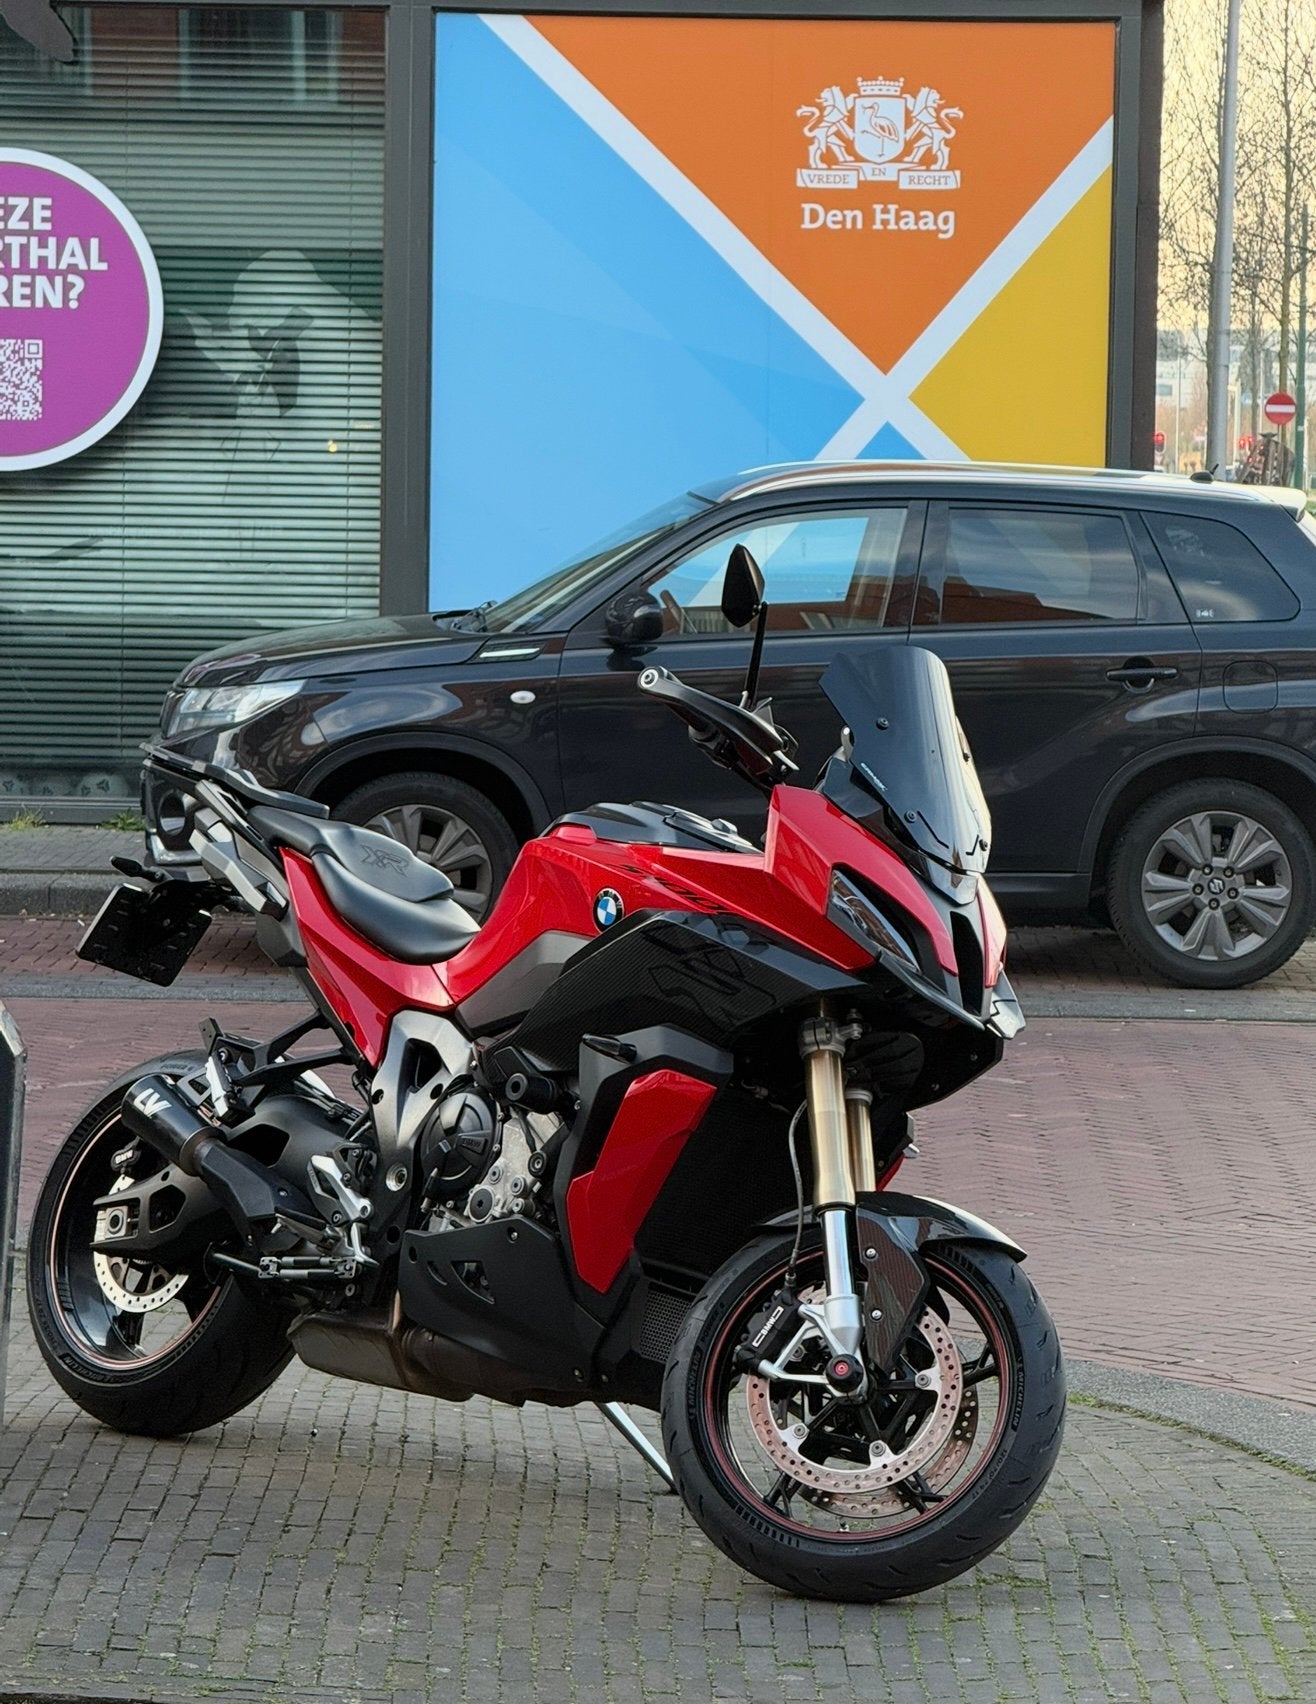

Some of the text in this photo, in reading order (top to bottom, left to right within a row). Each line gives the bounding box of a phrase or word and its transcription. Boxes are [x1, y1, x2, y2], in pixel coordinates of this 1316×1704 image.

[807, 167, 951, 186] VREDE EN RECHT
[0, 196, 53, 231] ZE
[800, 202, 956, 240] Den Haag
[0, 235, 109, 272] THAL
[598, 889, 623, 909] BMW
[133, 1087, 173, 1119] LV
[115, 1149, 134, 1164] BMW
[1012, 1371, 1025, 1427] MICHELIN
